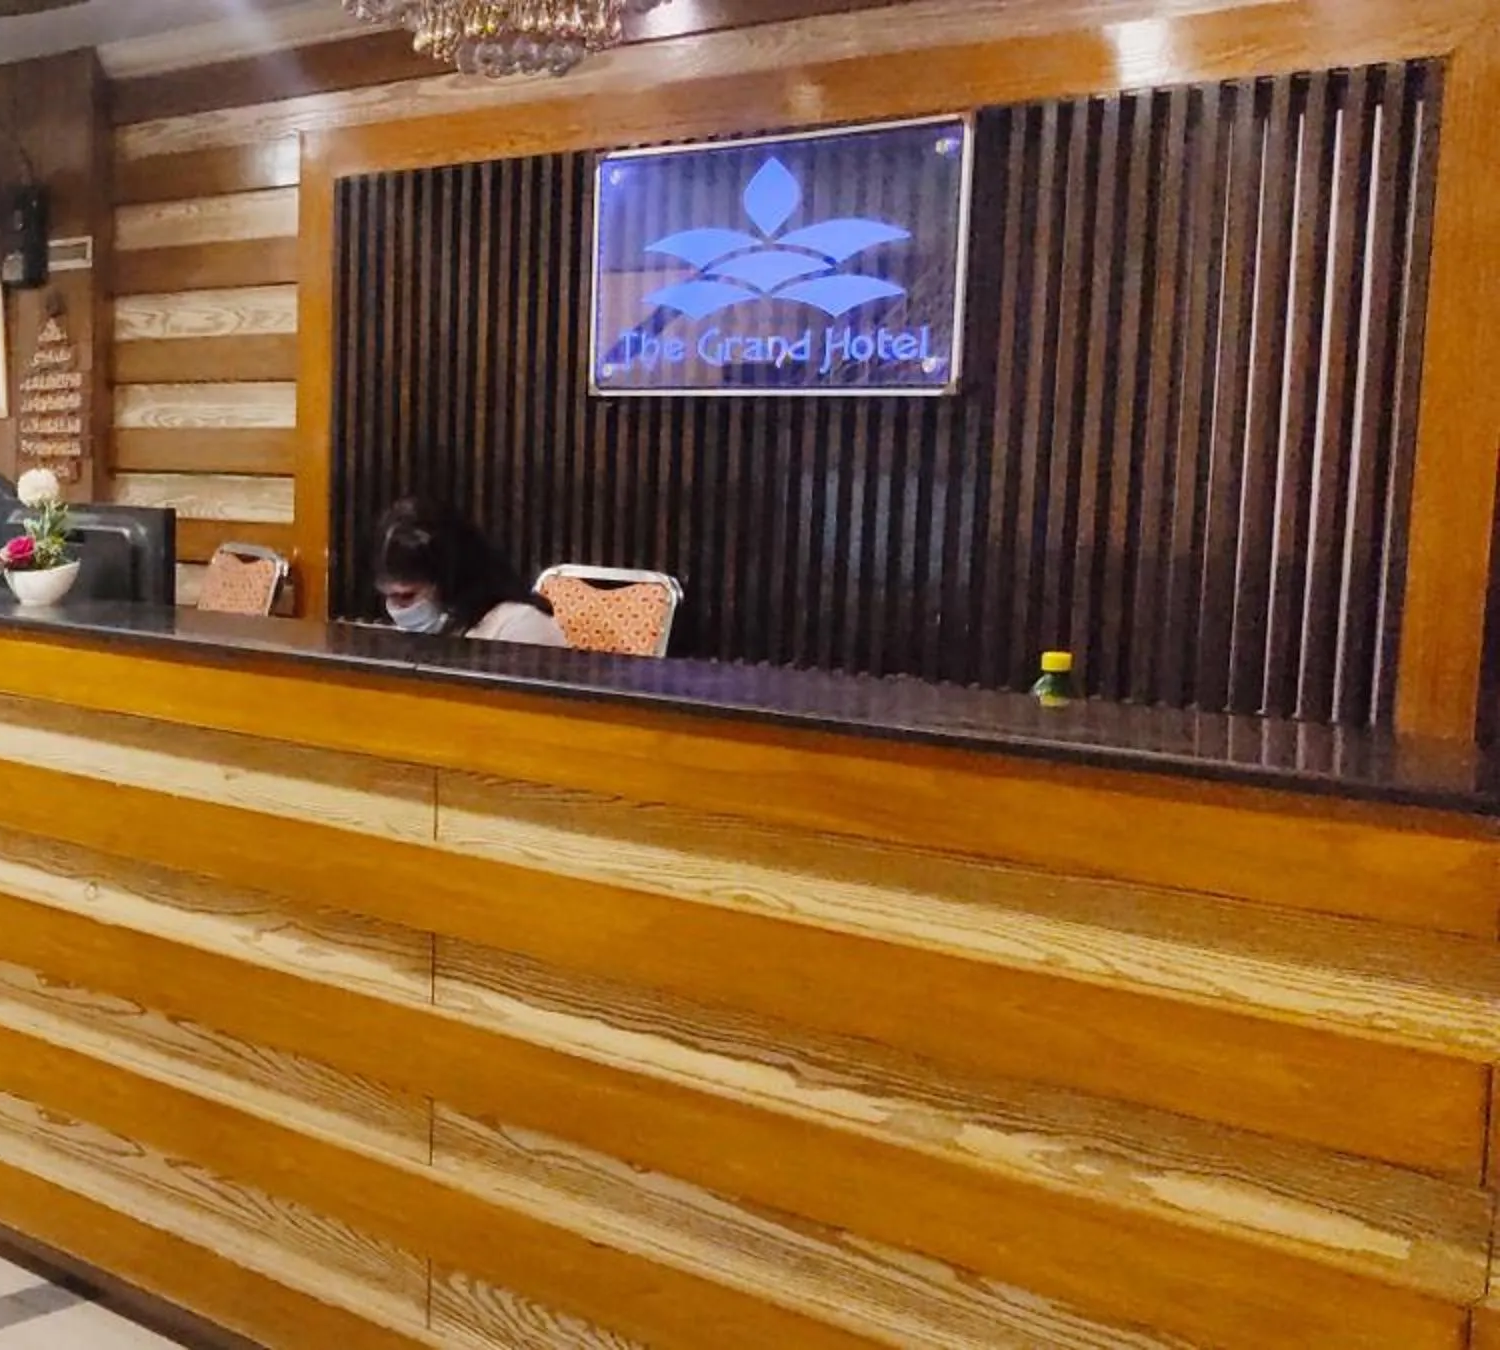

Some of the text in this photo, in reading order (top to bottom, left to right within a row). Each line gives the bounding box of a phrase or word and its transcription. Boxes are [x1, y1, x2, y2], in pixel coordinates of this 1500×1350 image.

[617, 324, 930, 374] The Grand Hotel
